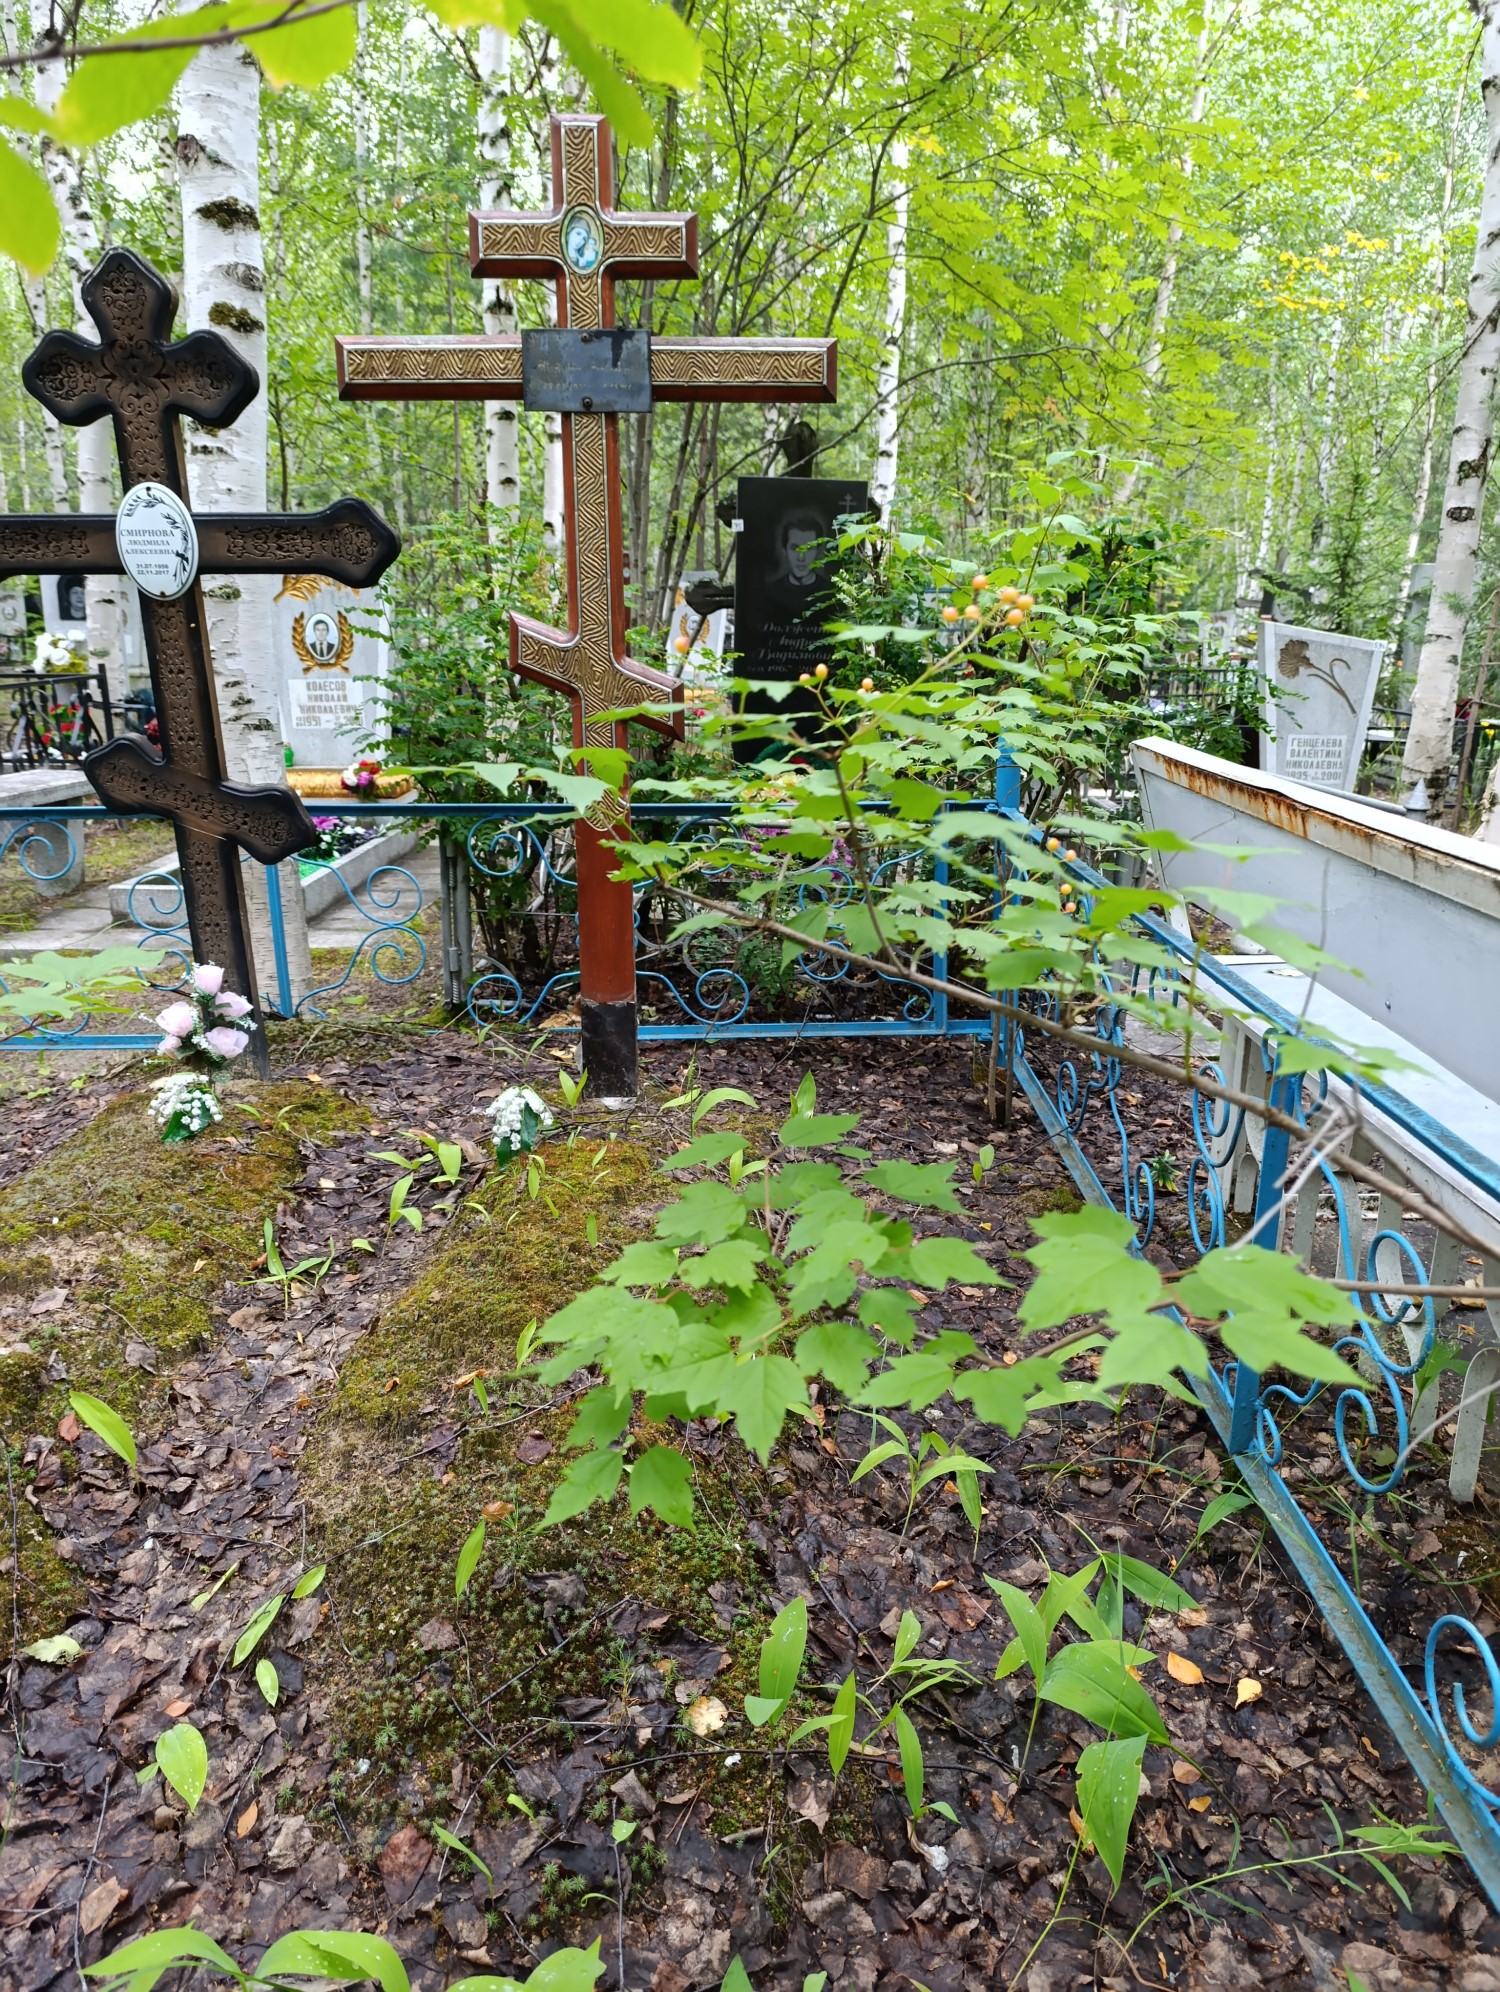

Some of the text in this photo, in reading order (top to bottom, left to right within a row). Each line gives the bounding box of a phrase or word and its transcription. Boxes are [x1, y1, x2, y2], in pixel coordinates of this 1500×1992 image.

[120, 529, 175, 537] СМИРНОВА
[758, 647, 834, 662] Вадимови
[306, 680, 347, 692] КОЛЕСОВ
[298, 703, 357, 715] НИКОЛАЕВИЧ
[1291, 737, 1343, 748] ГЕНЦЕЛЕВА
[1290, 748, 1342, 759] ВАЛЕНТИНА
[1285, 759, 1343, 770] НИКОЛАЕВНА
